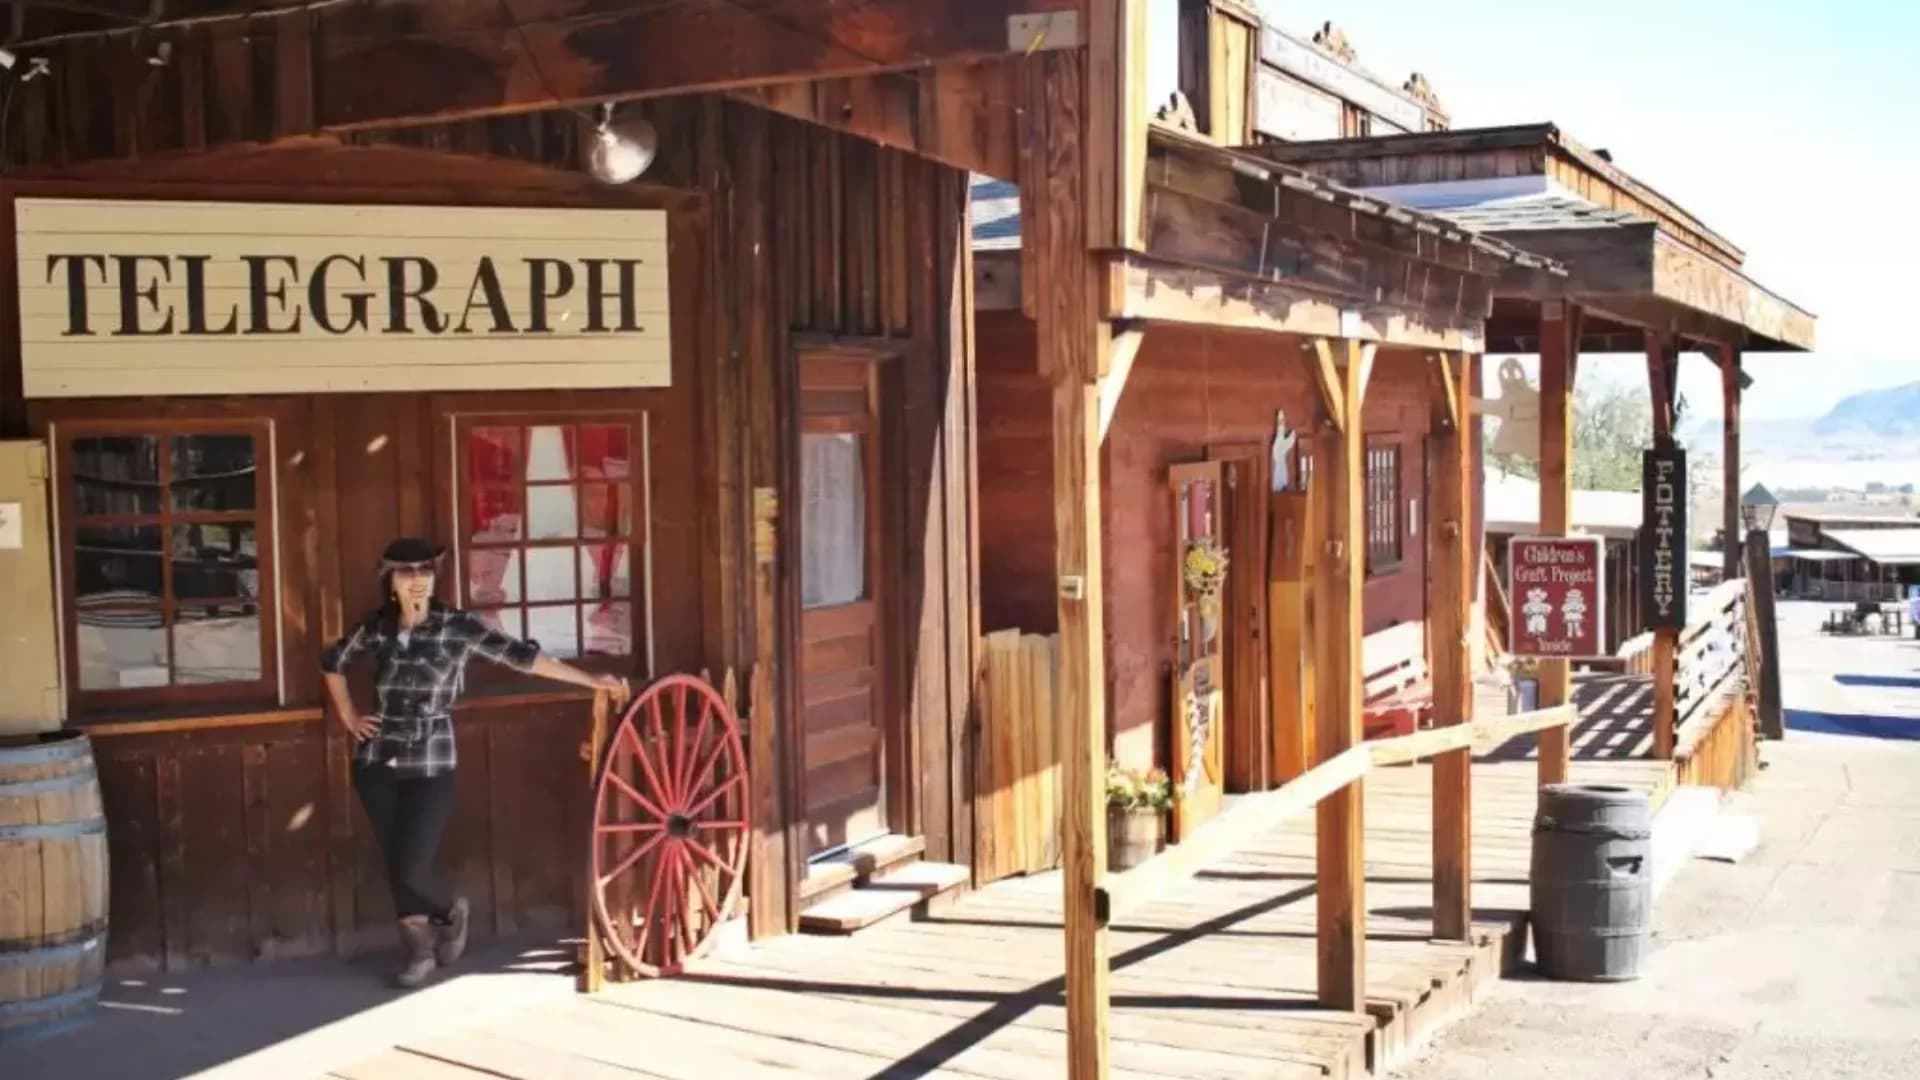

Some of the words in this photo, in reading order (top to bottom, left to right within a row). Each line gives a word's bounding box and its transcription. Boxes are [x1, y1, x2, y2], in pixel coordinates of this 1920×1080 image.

[47, 254, 644, 335] TELEGRAPH
[1523, 545, 1585, 563] Children's
[1655, 461, 1674, 615] POTTERY
[1515, 566, 1547, 582] Craft
[1551, 566, 1594, 585] Project
